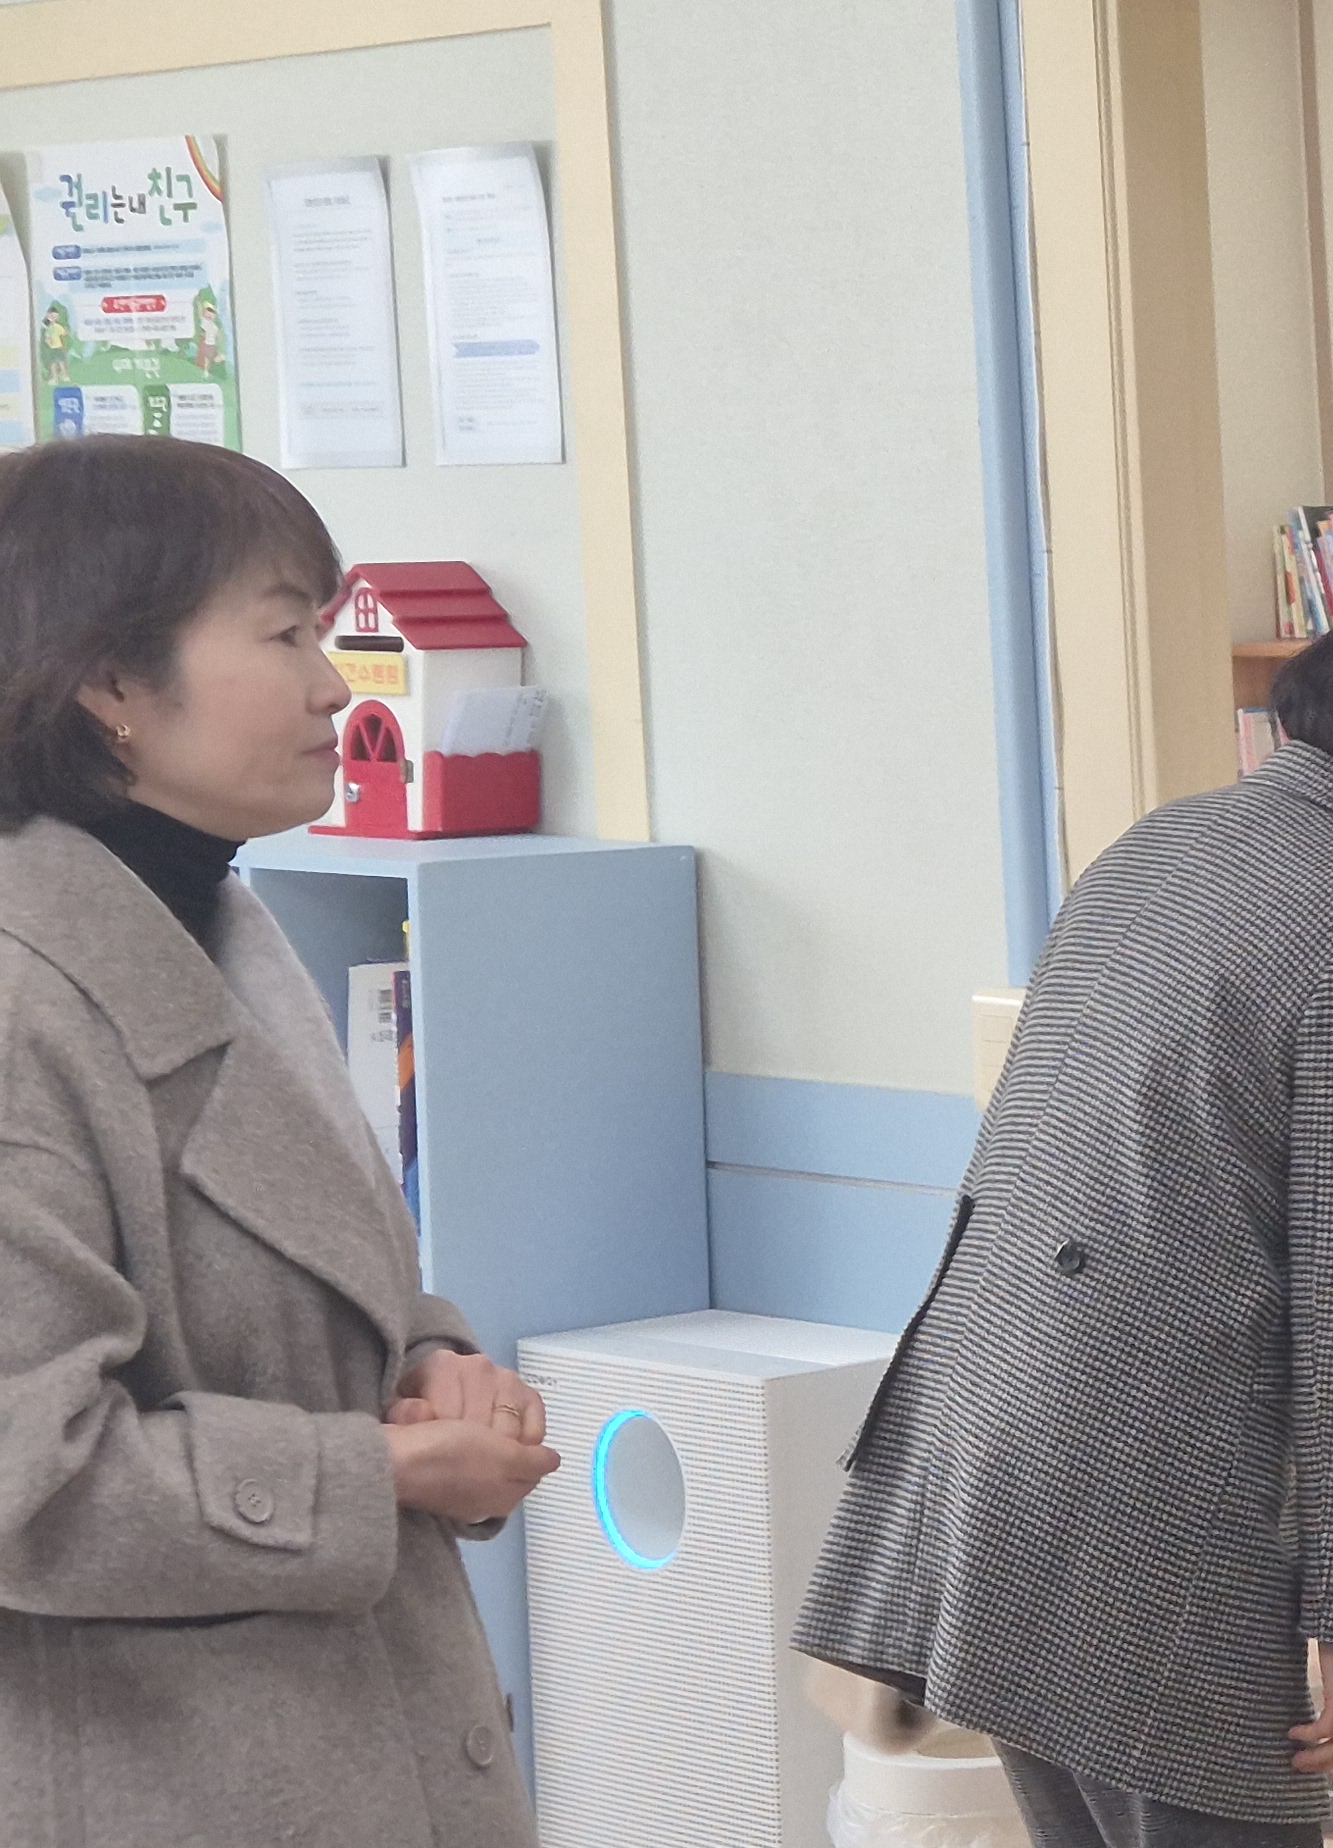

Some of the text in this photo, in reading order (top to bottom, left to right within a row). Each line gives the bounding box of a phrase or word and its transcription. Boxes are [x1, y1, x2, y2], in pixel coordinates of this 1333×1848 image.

[59, 166, 198, 232] 권리는 내 친구
